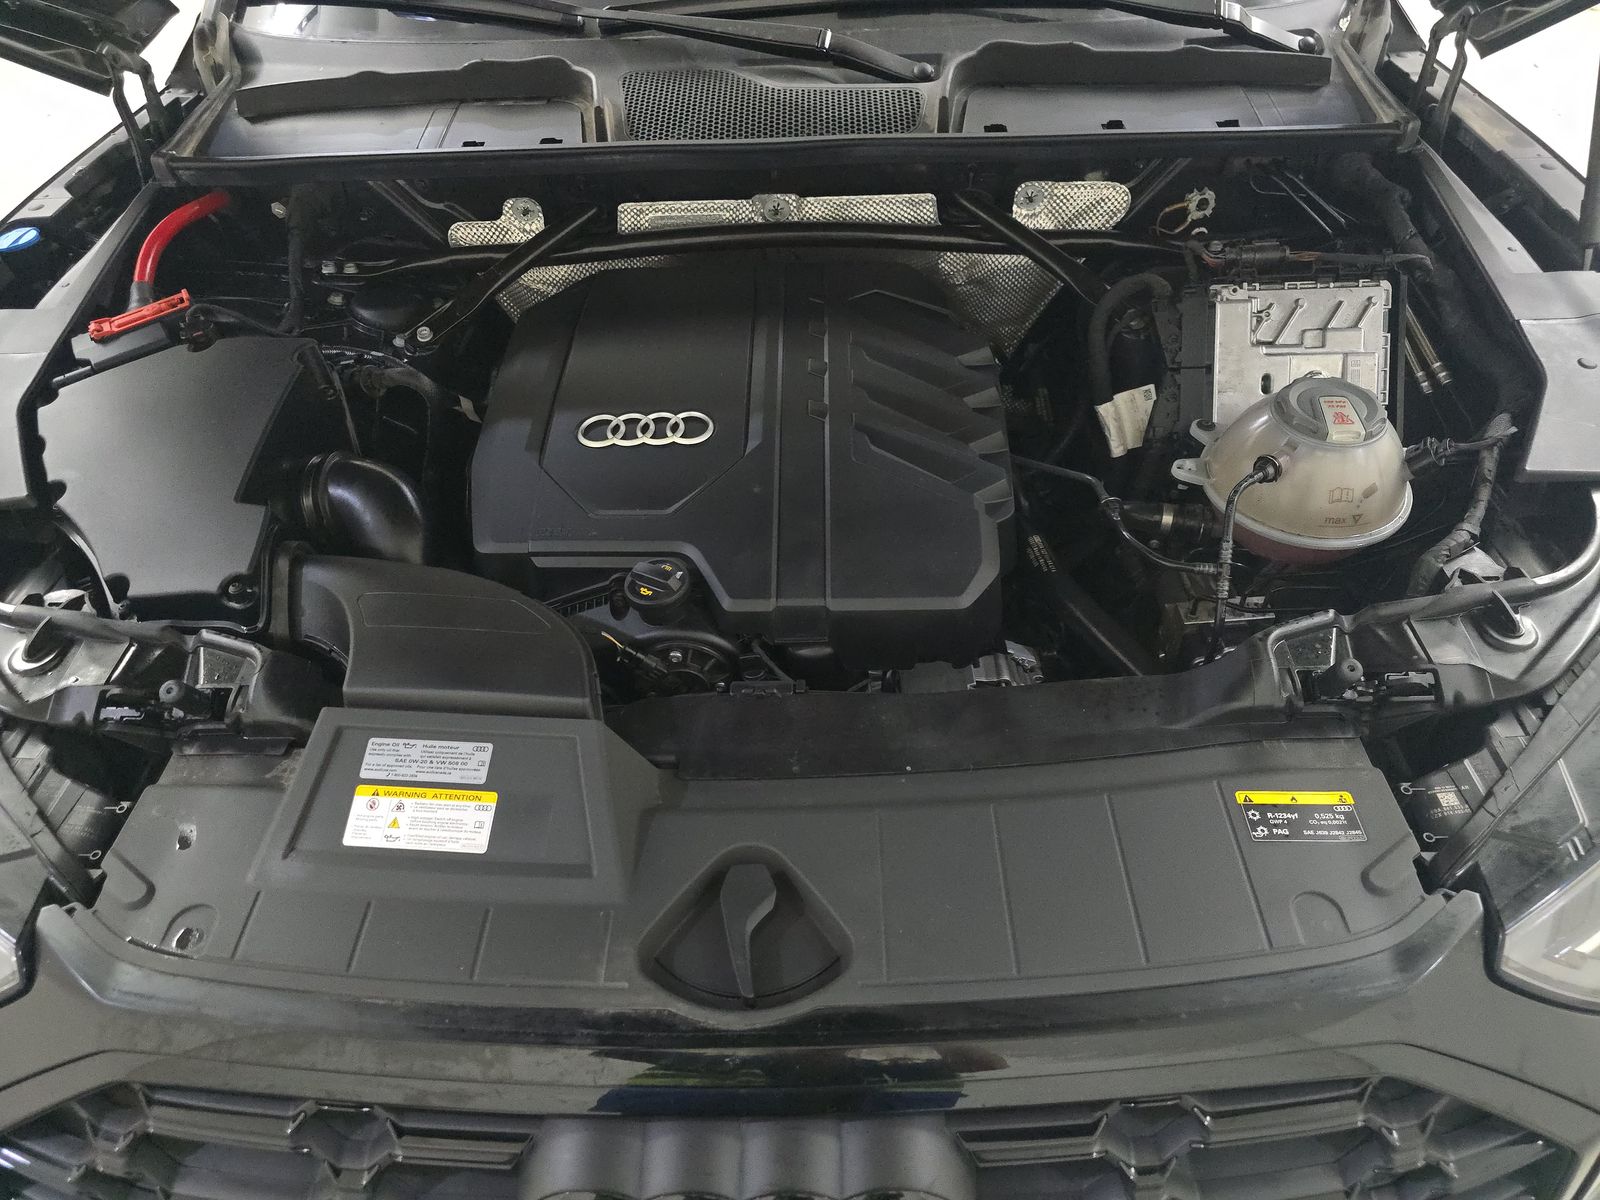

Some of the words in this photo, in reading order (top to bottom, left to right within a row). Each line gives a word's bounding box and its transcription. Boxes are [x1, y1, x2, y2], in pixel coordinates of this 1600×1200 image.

[1324, 517, 1346, 525] max
[384, 790, 427, 799] WARNING
[432, 792, 482, 802] ATTENTION
